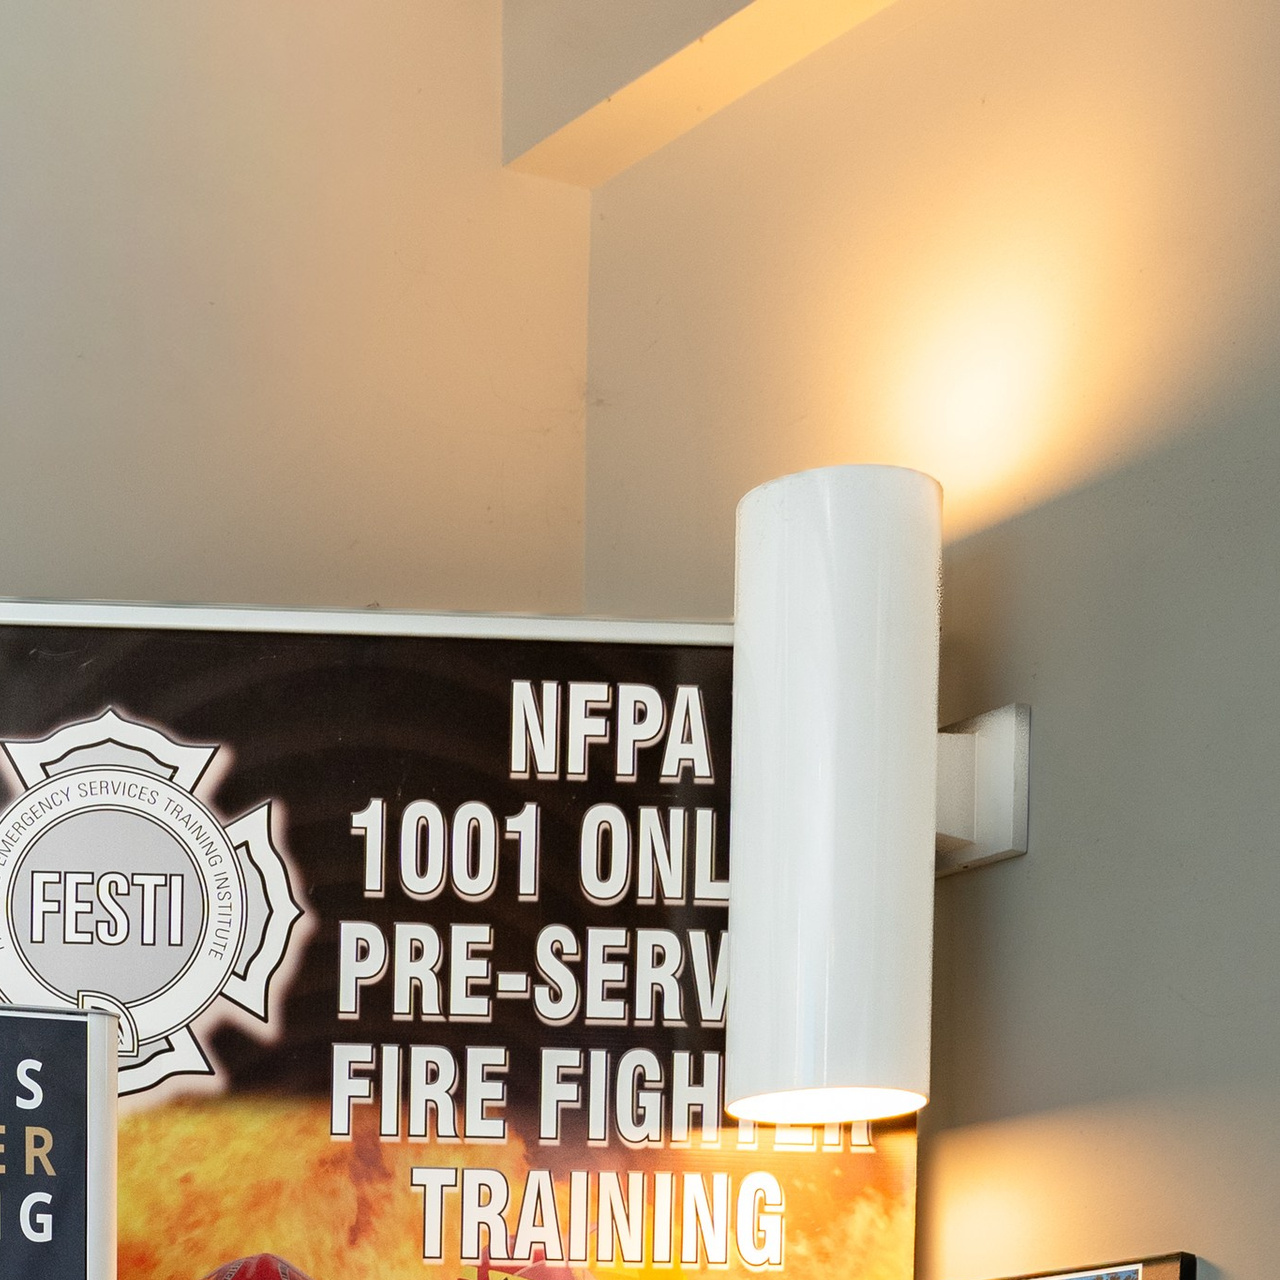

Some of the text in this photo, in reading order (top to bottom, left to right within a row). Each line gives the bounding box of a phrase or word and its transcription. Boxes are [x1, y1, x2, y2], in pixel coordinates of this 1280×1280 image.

[510, 680, 714, 785] NFPA
[77, 780, 160, 806] SERVICES
[163, 797, 223, 868] TRAINING
[208, 871, 233, 961] INSTITUTE
[350, 800, 731, 906] 1001 ONL
[30, 870, 185, 947] FESTI
[337, 921, 729, 1027] PRE-SERV
[331, 1044, 509, 1144] FIRE
[410, 1168, 787, 1270] TRAINING
